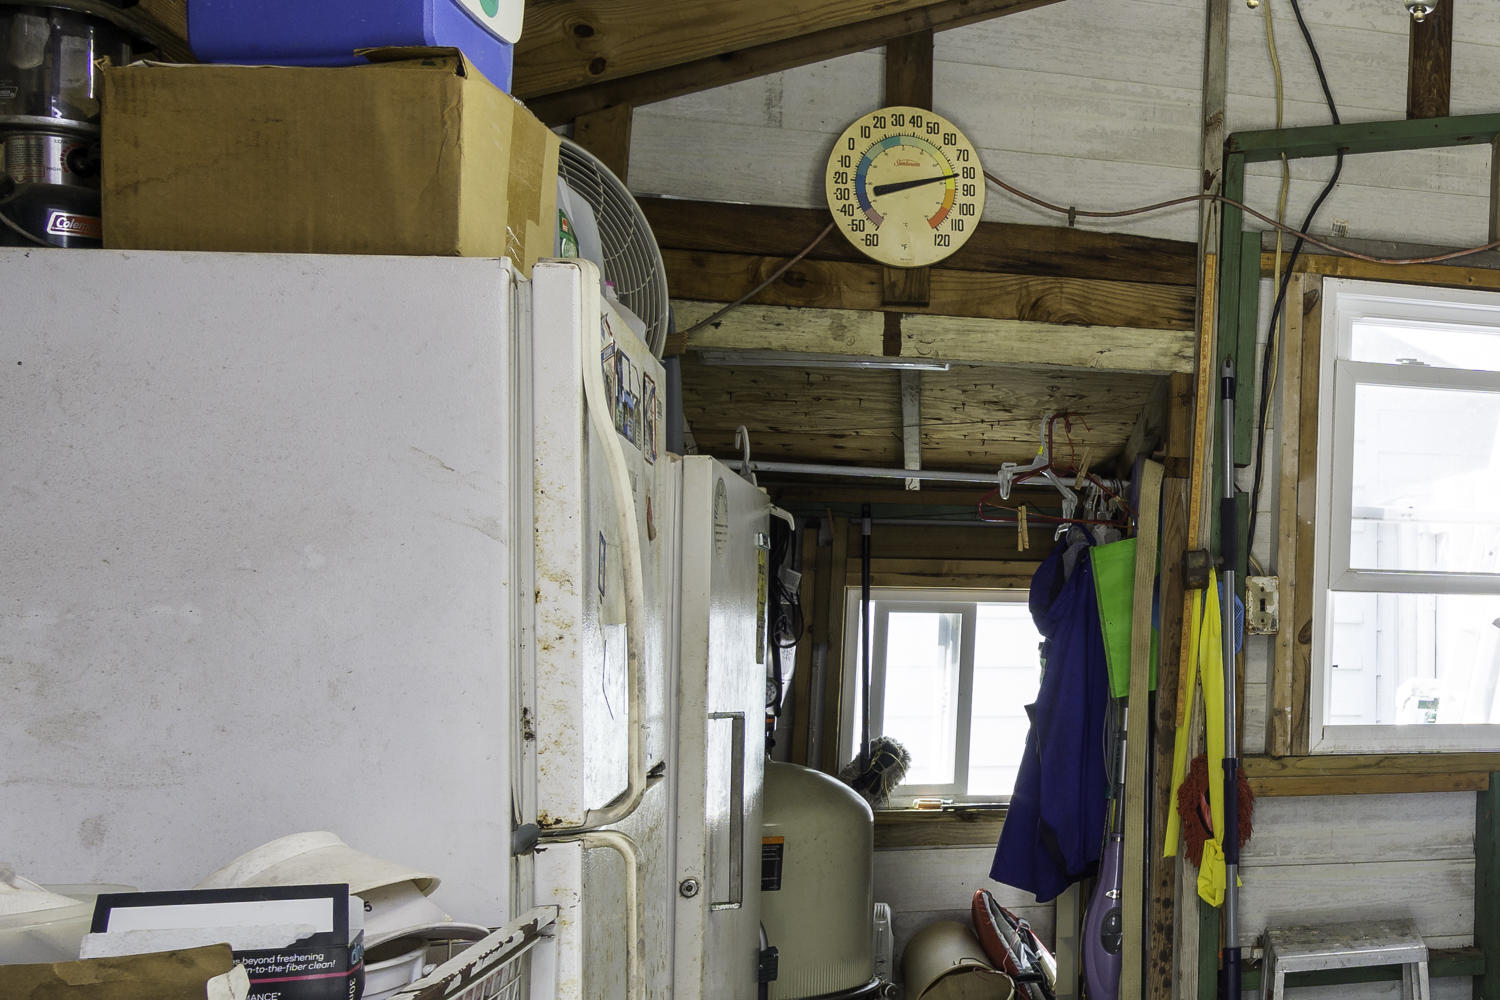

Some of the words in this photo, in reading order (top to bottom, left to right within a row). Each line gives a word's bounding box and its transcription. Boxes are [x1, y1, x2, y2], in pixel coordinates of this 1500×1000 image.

[873, 116, 886, 129] 20
[891, 114, 905, 127] 30
[909, 115, 923, 128] 40
[860, 126, 871, 138] 10
[926, 121, 940, 135] 50
[848, 138, 855, 150] 0
[943, 133, 957, 146] 60
[837, 155, 851, 168] -10
[956, 149, 970, 162] 70
[832, 171, 848, 185] -20
[962, 167, 975, 180] 80
[833, 187, 850, 201] -30
[962, 184, 976, 197] 90
[836, 204, 854, 217] -40
[958, 203, 975, 216] 100
[56, 216, 92, 231] Colem
[847, 219, 865, 232] -50
[950, 219, 964, 231] 110
[860, 234, 879, 247] -60
[934, 234, 950, 247] 120
[243, 954, 275, 965] beyond
[277, 953, 324, 963] freshening
[244, 963, 307, 974] n-to-the-fiber
[308, 960, 336, 970] clean!
